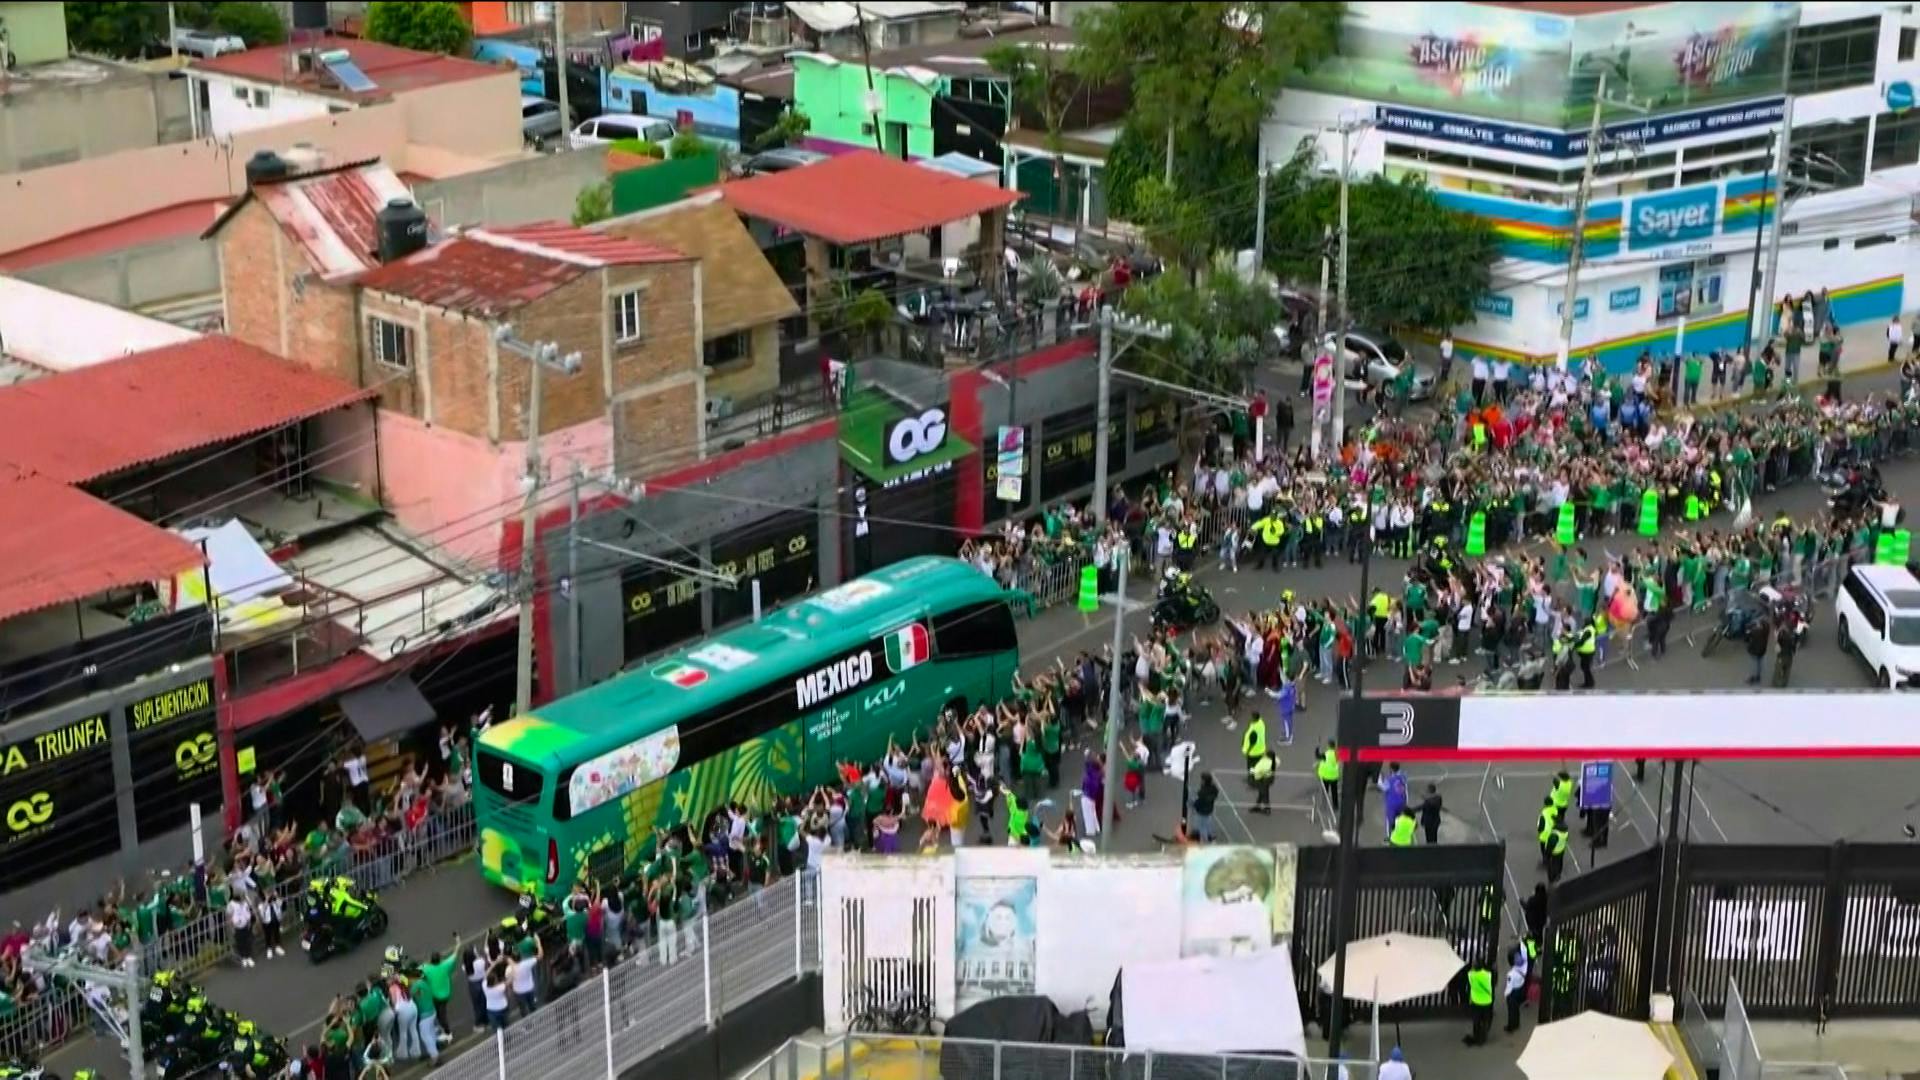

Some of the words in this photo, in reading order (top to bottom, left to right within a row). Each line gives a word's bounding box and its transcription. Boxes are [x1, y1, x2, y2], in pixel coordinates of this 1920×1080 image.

[1637, 202, 1711, 237] Sayer
[796, 650, 873, 710] MEXICO
[133, 680, 210, 729] SUPLEMENTACIÓN
[1378, 702, 1415, 746] 3
[0, 745, 28, 776] A
[35, 716, 108, 762] TRIUNFA
[6, 791, 54, 832] OG
